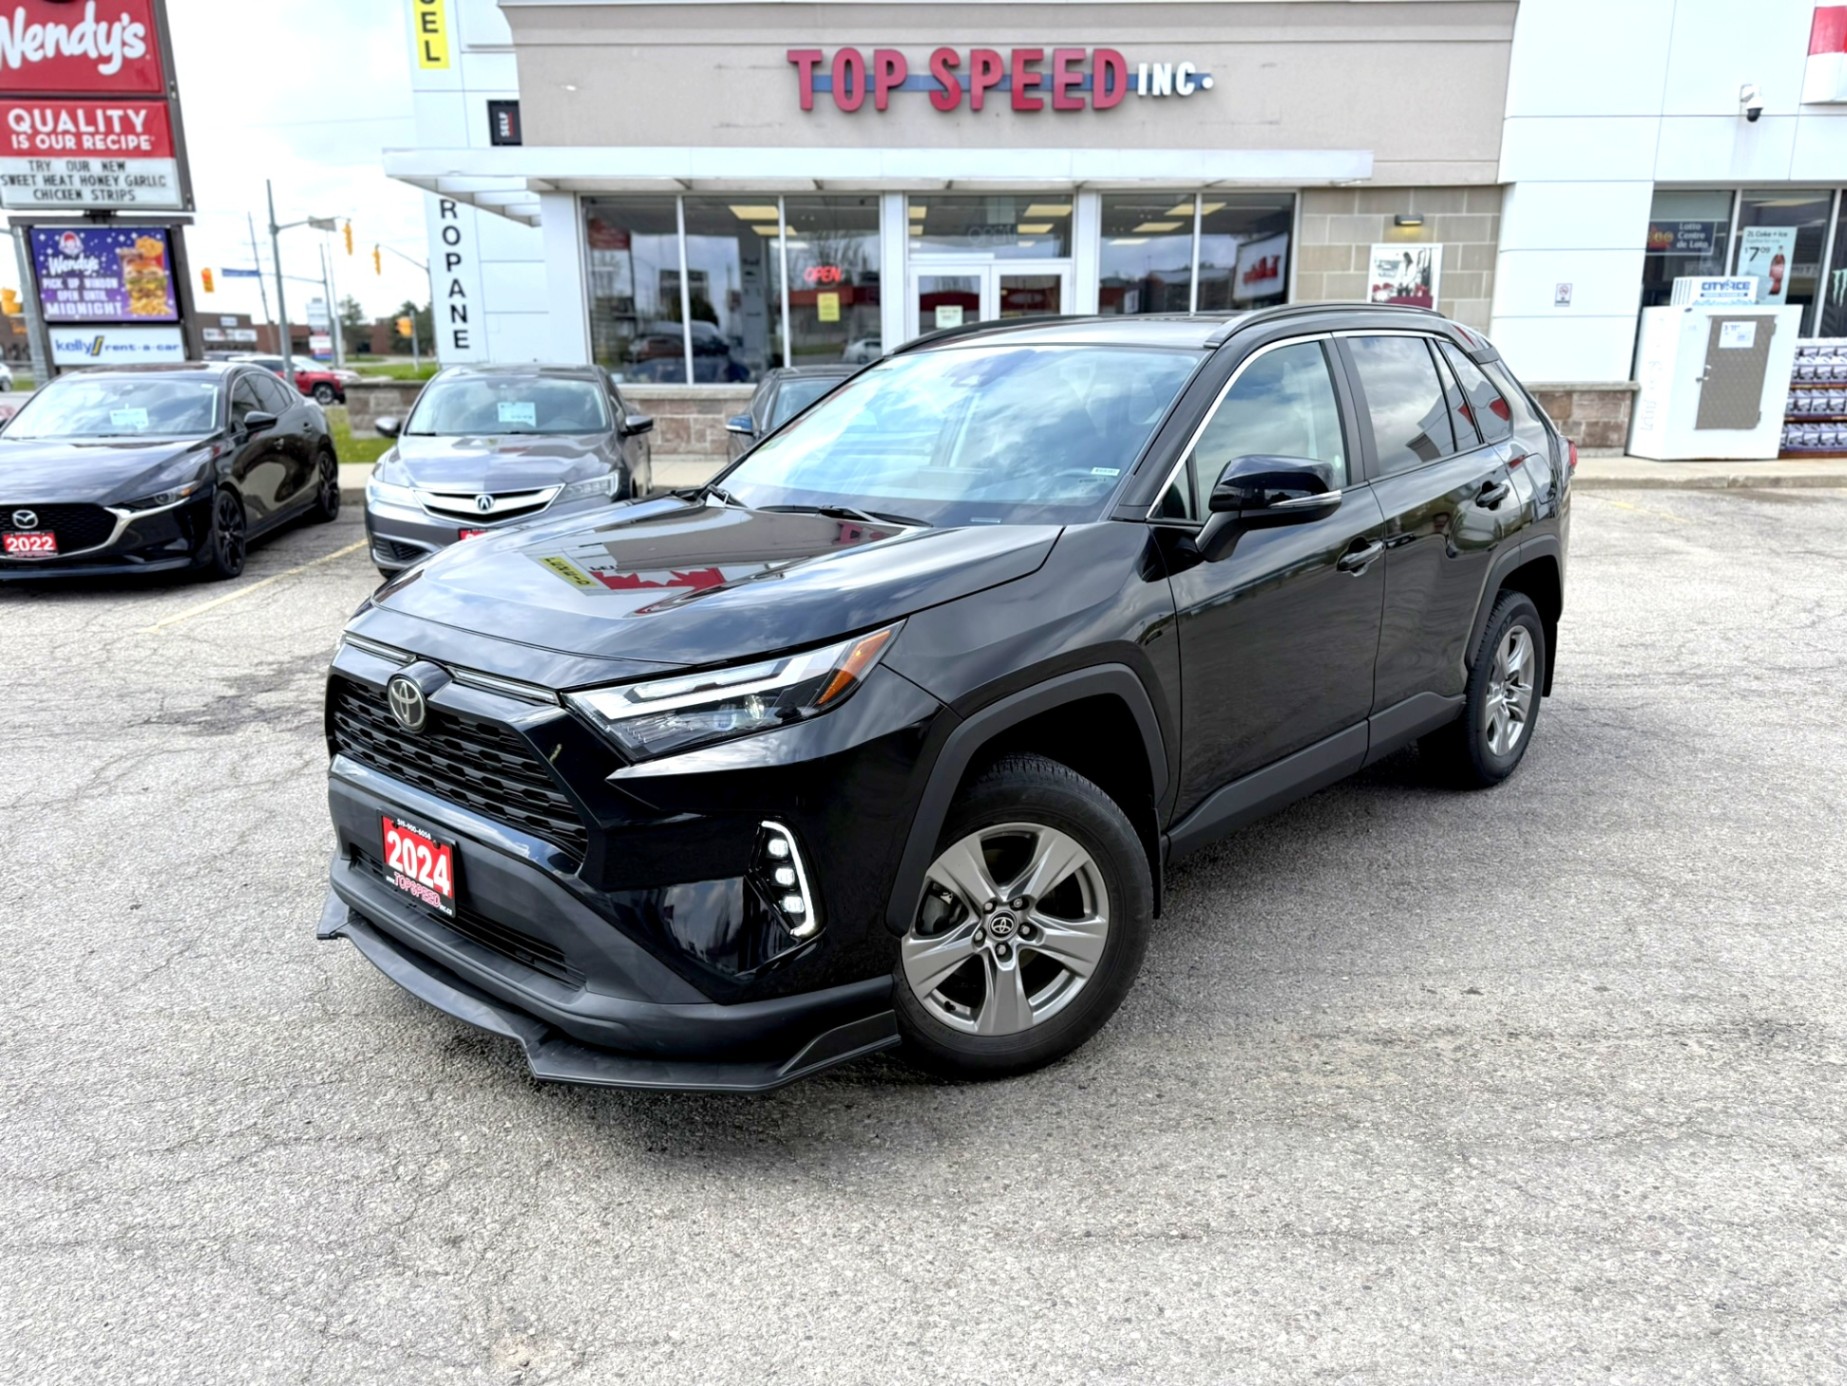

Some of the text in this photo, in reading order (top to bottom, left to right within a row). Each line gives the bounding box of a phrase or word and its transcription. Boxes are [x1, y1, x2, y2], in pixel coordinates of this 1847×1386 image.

[0, 0, 146, 75] Wendy's
[420, 0, 441, 62] EL
[787, 47, 907, 111] TOP
[929, 47, 1127, 111] SPEED
[8, 108, 147, 133] QUALITY
[12, 134, 152, 150] IS OUR RECIPE
[28, 160, 126, 172] TRY OUR NEW
[1, 175, 37, 187] SWEET
[44, 175, 74, 187] HEAT
[80, 175, 119, 187] HONEY
[33, 188, 136, 201] CHICKEN STRIPS
[1677, 231, 1706, 239] Centre
[1676, 240, 1687, 248] de
[48, 252, 100, 276] Wendy's
[439, 198, 470, 349] ROPANE
[804, 266, 842, 283] OPEN
[67, 278, 80, 289] UP
[57, 290, 79, 301] OPEN
[46, 302, 122, 315] MIDNIGHT
[55, 340, 92, 354] kelly
[6, 536, 55, 552] 2022
[387, 830, 450, 896] 2024
